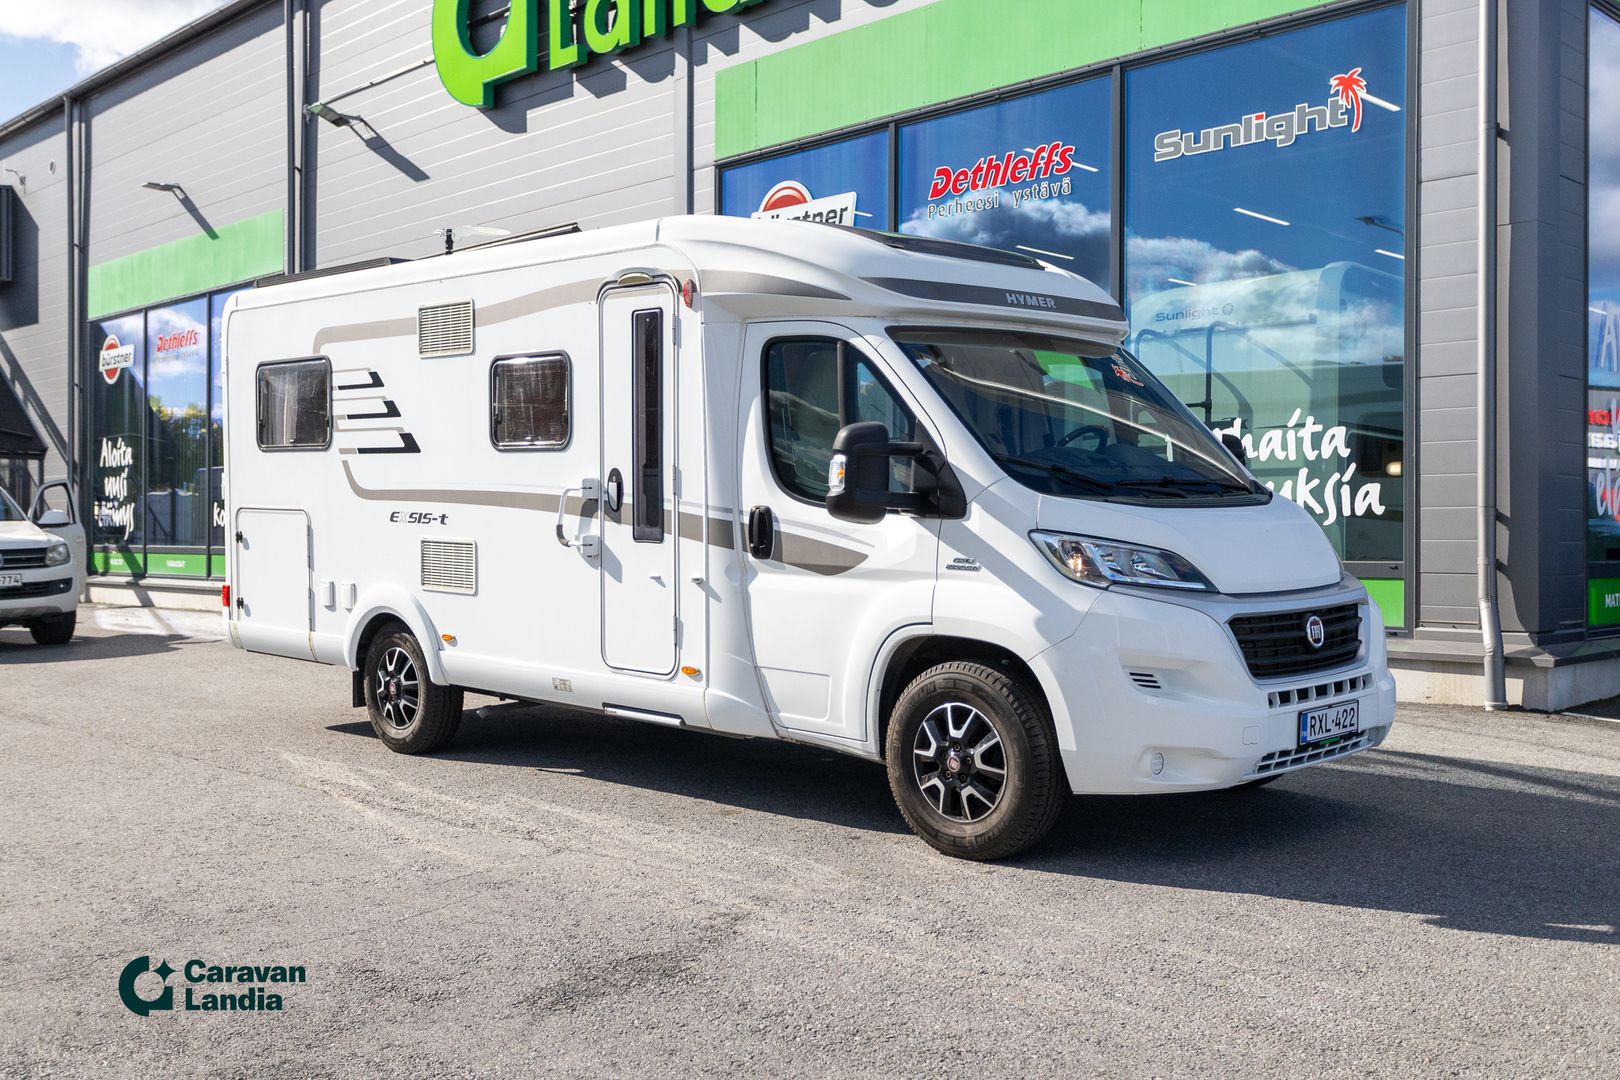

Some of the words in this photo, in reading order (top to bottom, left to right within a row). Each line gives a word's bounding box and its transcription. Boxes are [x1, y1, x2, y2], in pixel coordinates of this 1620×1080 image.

[1154, 95, 1348, 162] Sunlight
[928, 141, 1075, 200] Dethleffs
[928, 191, 999, 219] Perheesi
[1013, 177, 1071, 208] ystävä
[1006, 292, 1056, 309] HYMER
[156, 329, 199, 353] Dethleffs
[101, 352, 132, 367] bürstner
[100, 437, 133, 468] Aloita
[104, 467, 128, 501] uusi
[1309, 707, 1355, 736] RXL-422
